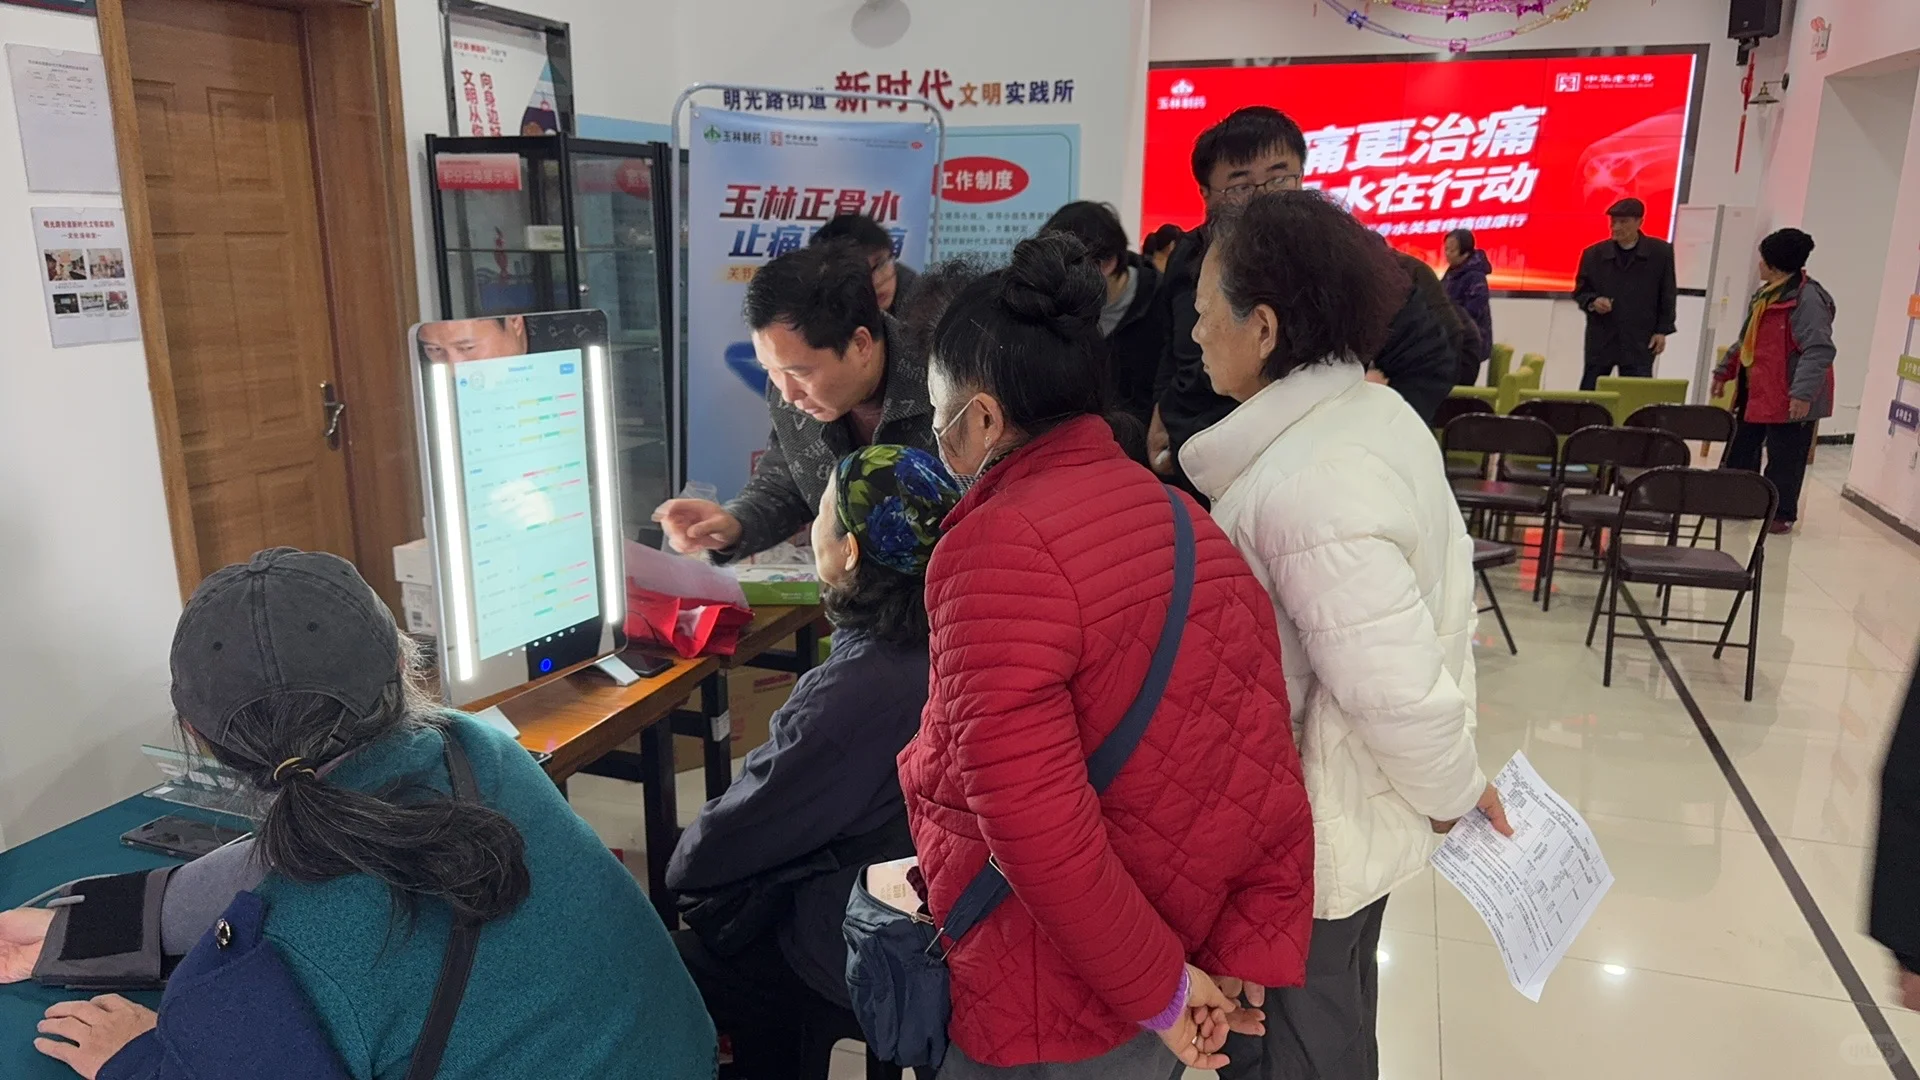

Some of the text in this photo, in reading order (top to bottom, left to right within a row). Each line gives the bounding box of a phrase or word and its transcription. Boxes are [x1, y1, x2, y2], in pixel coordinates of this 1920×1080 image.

[723, 131, 762, 145] 玉林制药
[1303, 105, 1547, 175] 痛更治痛
[942, 170, 1013, 191] 工作制度
[1303, 162, 1539, 214] 水在行动
[719, 184, 902, 223] 玉林正骨水
